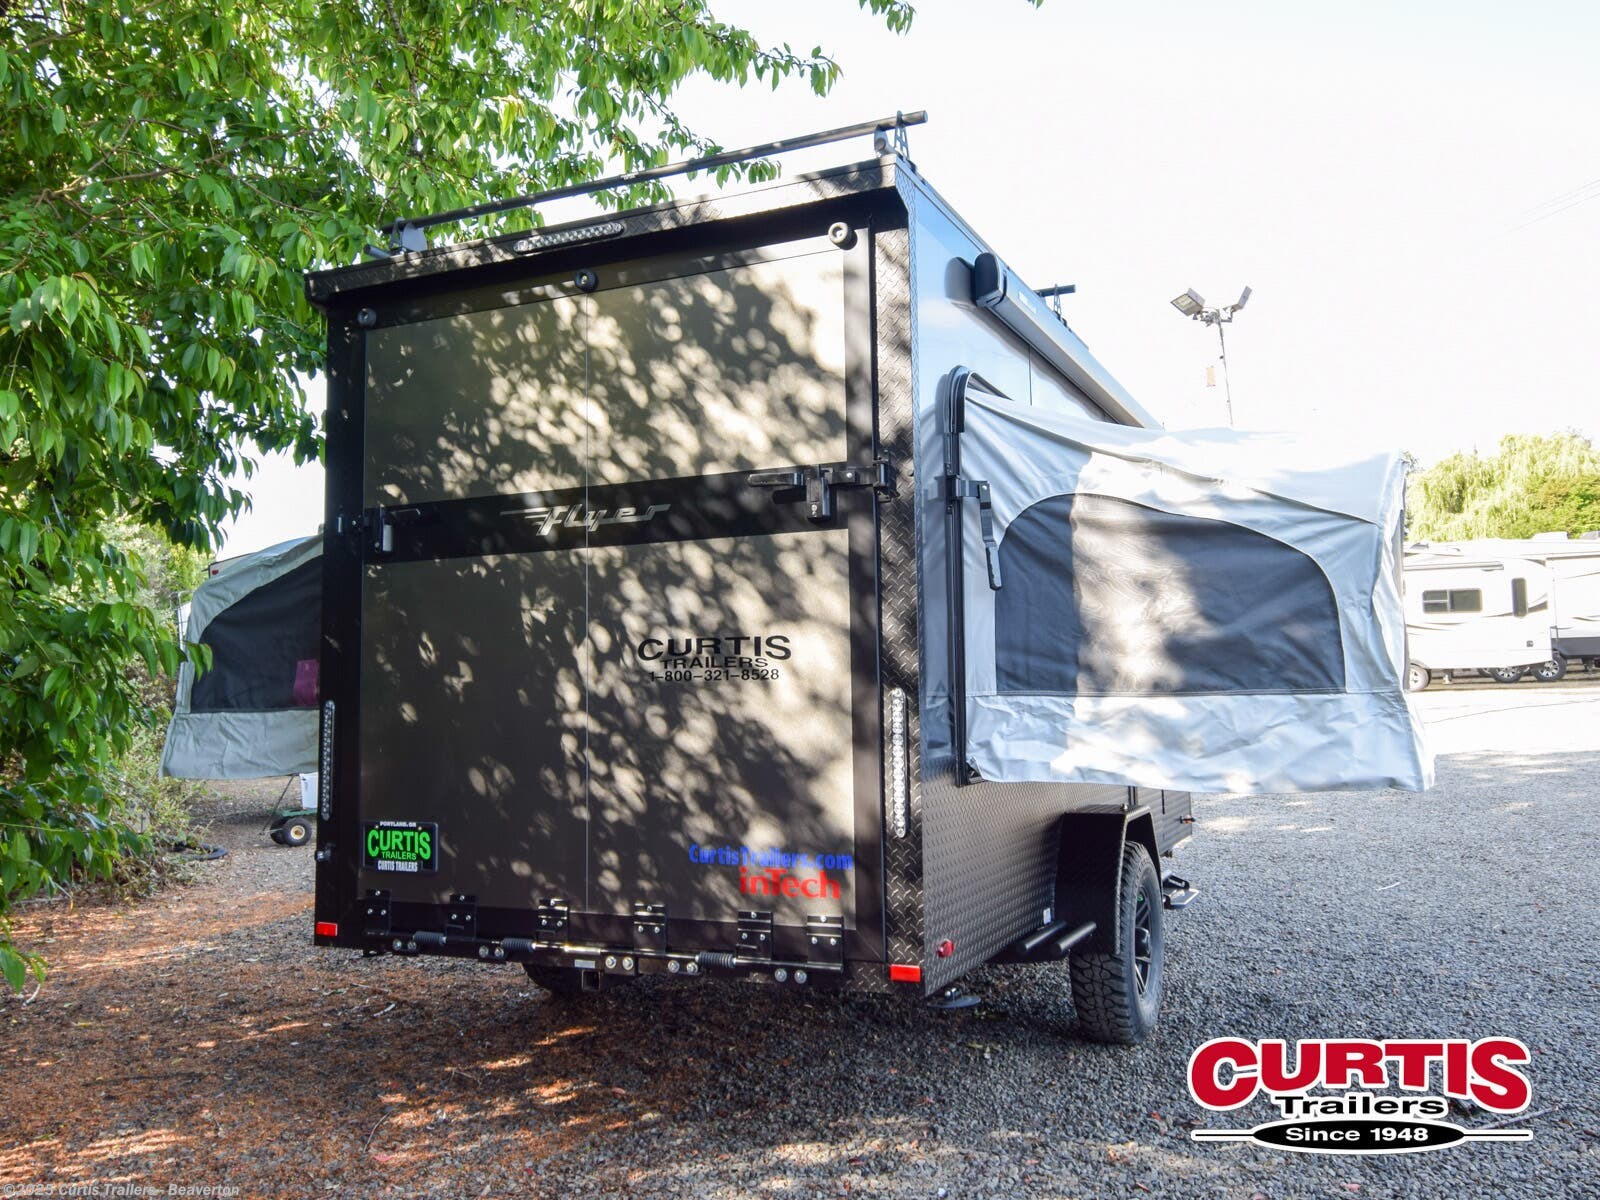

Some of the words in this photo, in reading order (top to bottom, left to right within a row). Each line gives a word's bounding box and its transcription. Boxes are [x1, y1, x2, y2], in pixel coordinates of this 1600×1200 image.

[499, 503, 671, 536] Flyer
[638, 635, 792, 661] CURTIS
[649, 668, 780, 682] 1-800-321-8528
[660, 656, 768, 669] TRAILERS
[368, 829, 431, 860] CURTIS
[382, 851, 417, 860] TRAILERS
[689, 844, 854, 870] CurtisTrailers.com
[378, 860, 395, 871] CURTIS
[395, 861, 418, 872] TRAILERS
[739, 867, 841, 899] inTech
